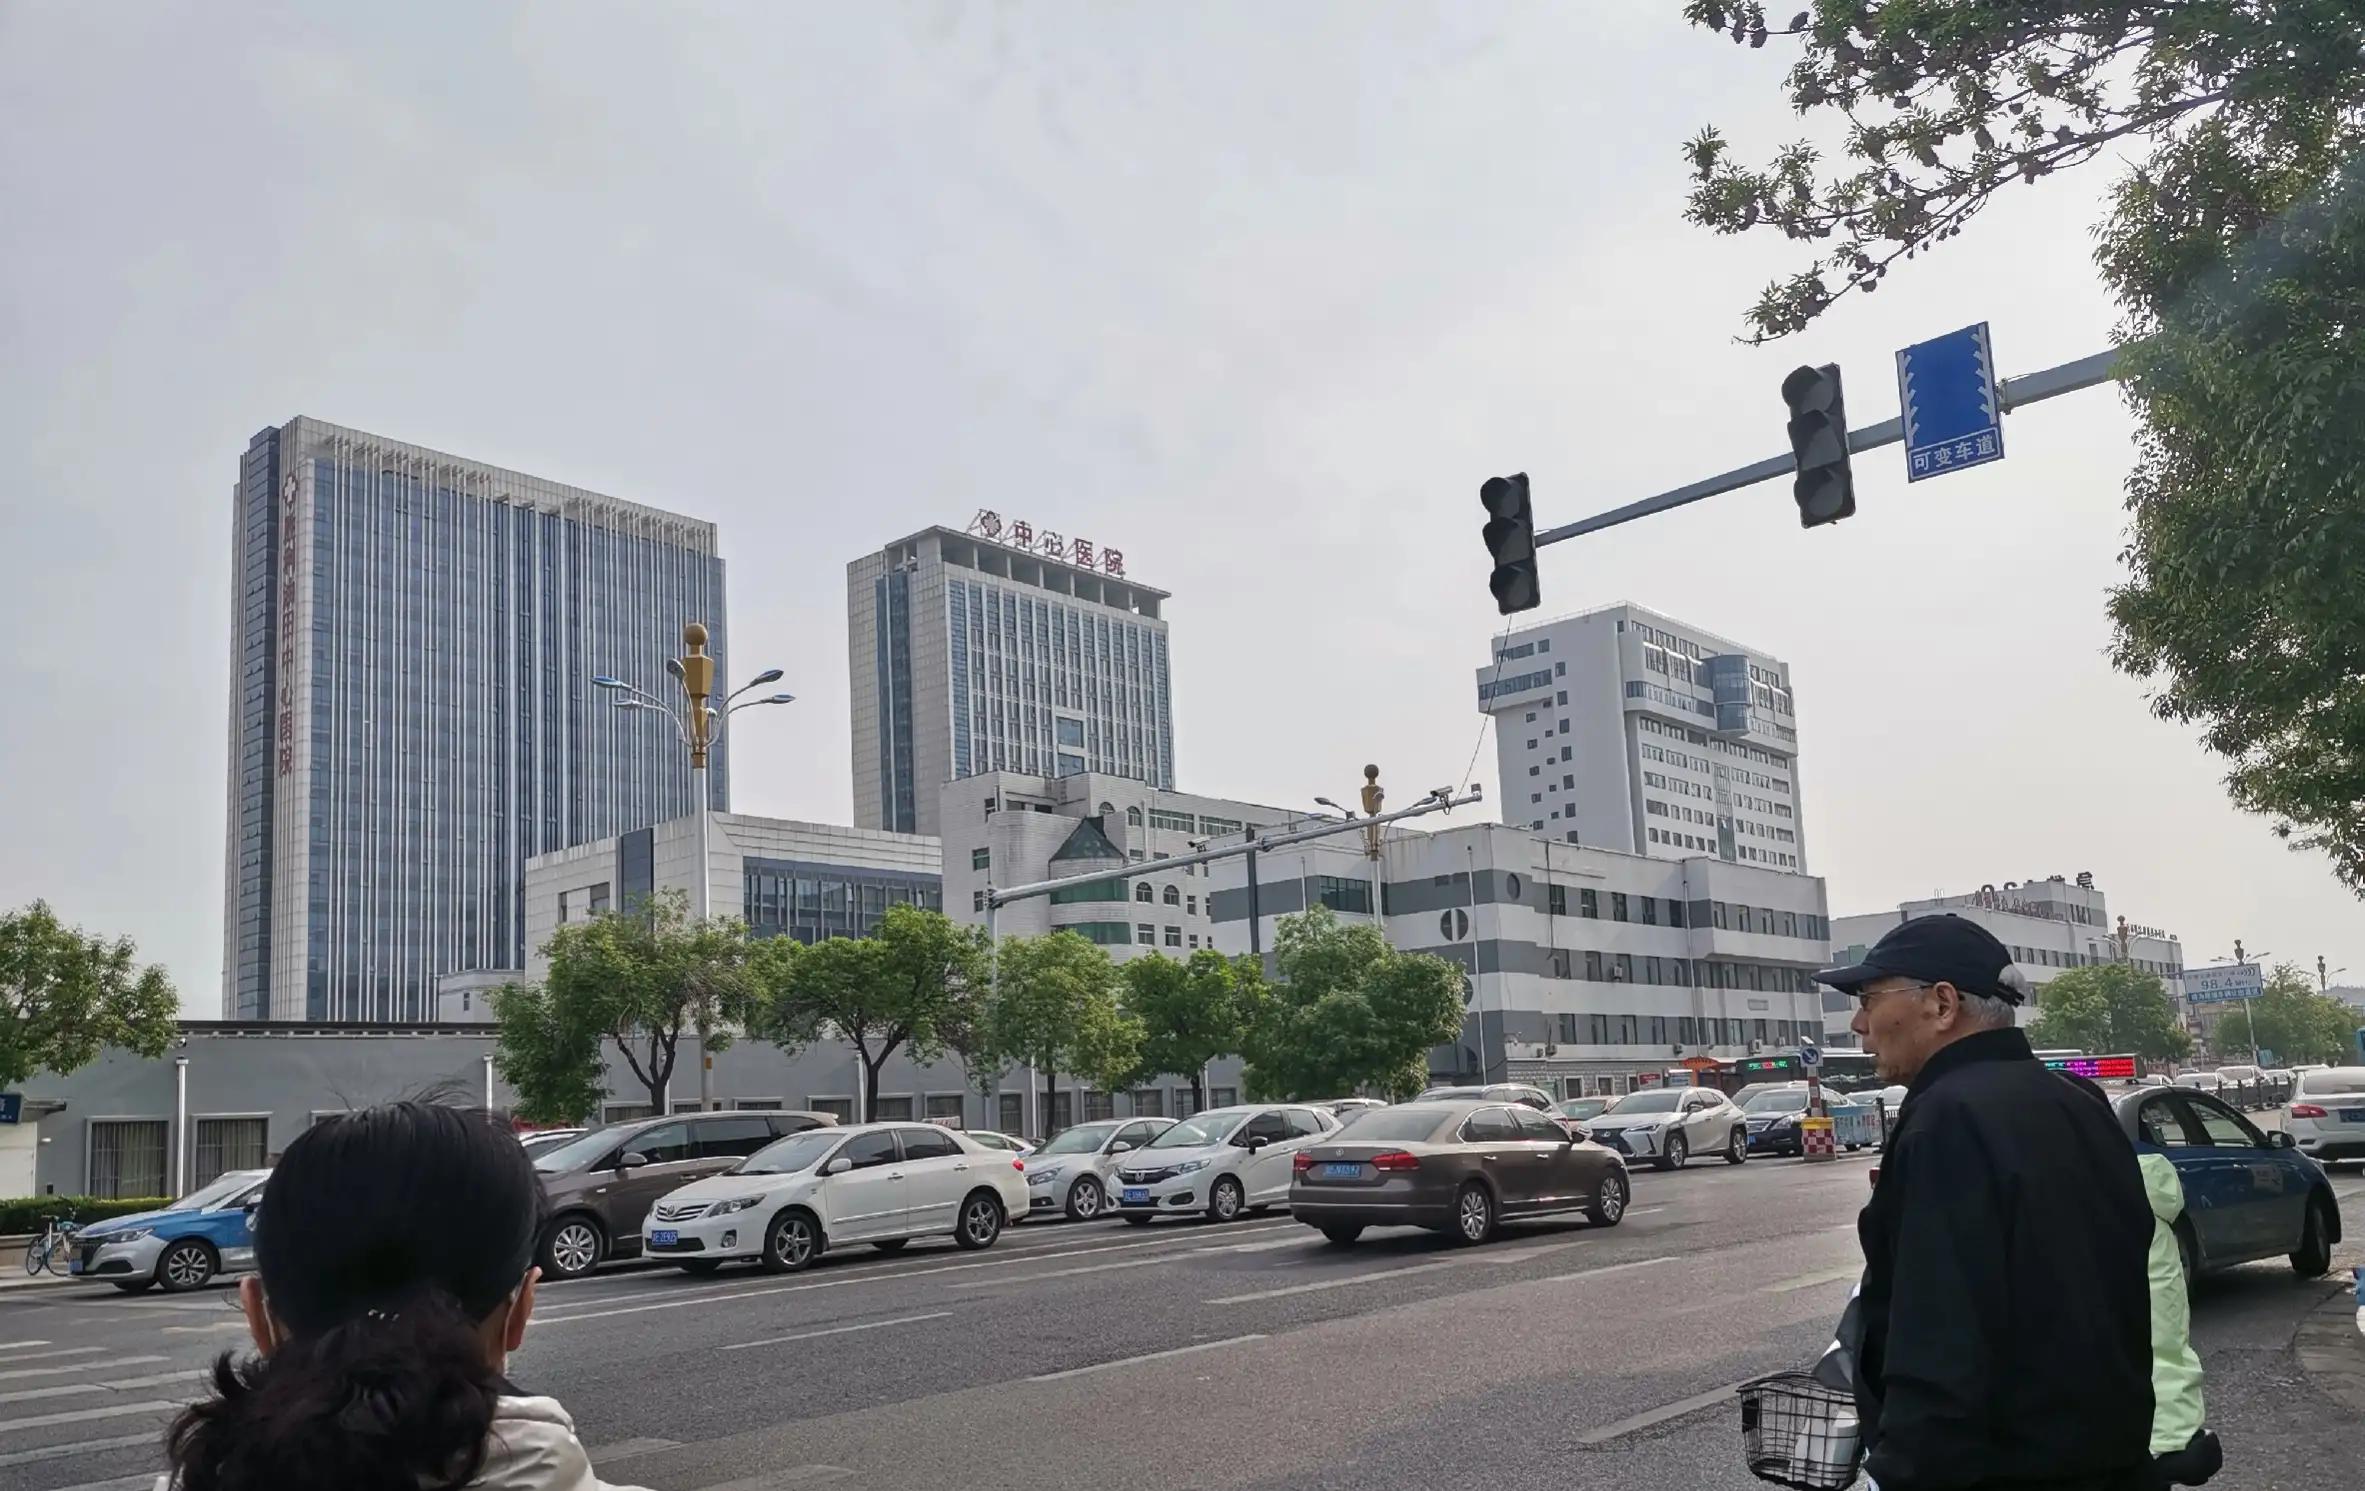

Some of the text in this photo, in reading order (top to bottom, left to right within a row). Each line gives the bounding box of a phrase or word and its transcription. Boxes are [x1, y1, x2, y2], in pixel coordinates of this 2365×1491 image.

[1913, 434, 1996, 471] 可变车道
[1015, 520, 1126, 574] 中心医院
[280, 514, 296, 778] 田中心医院
[2201, 977, 2233, 991] 98.4
